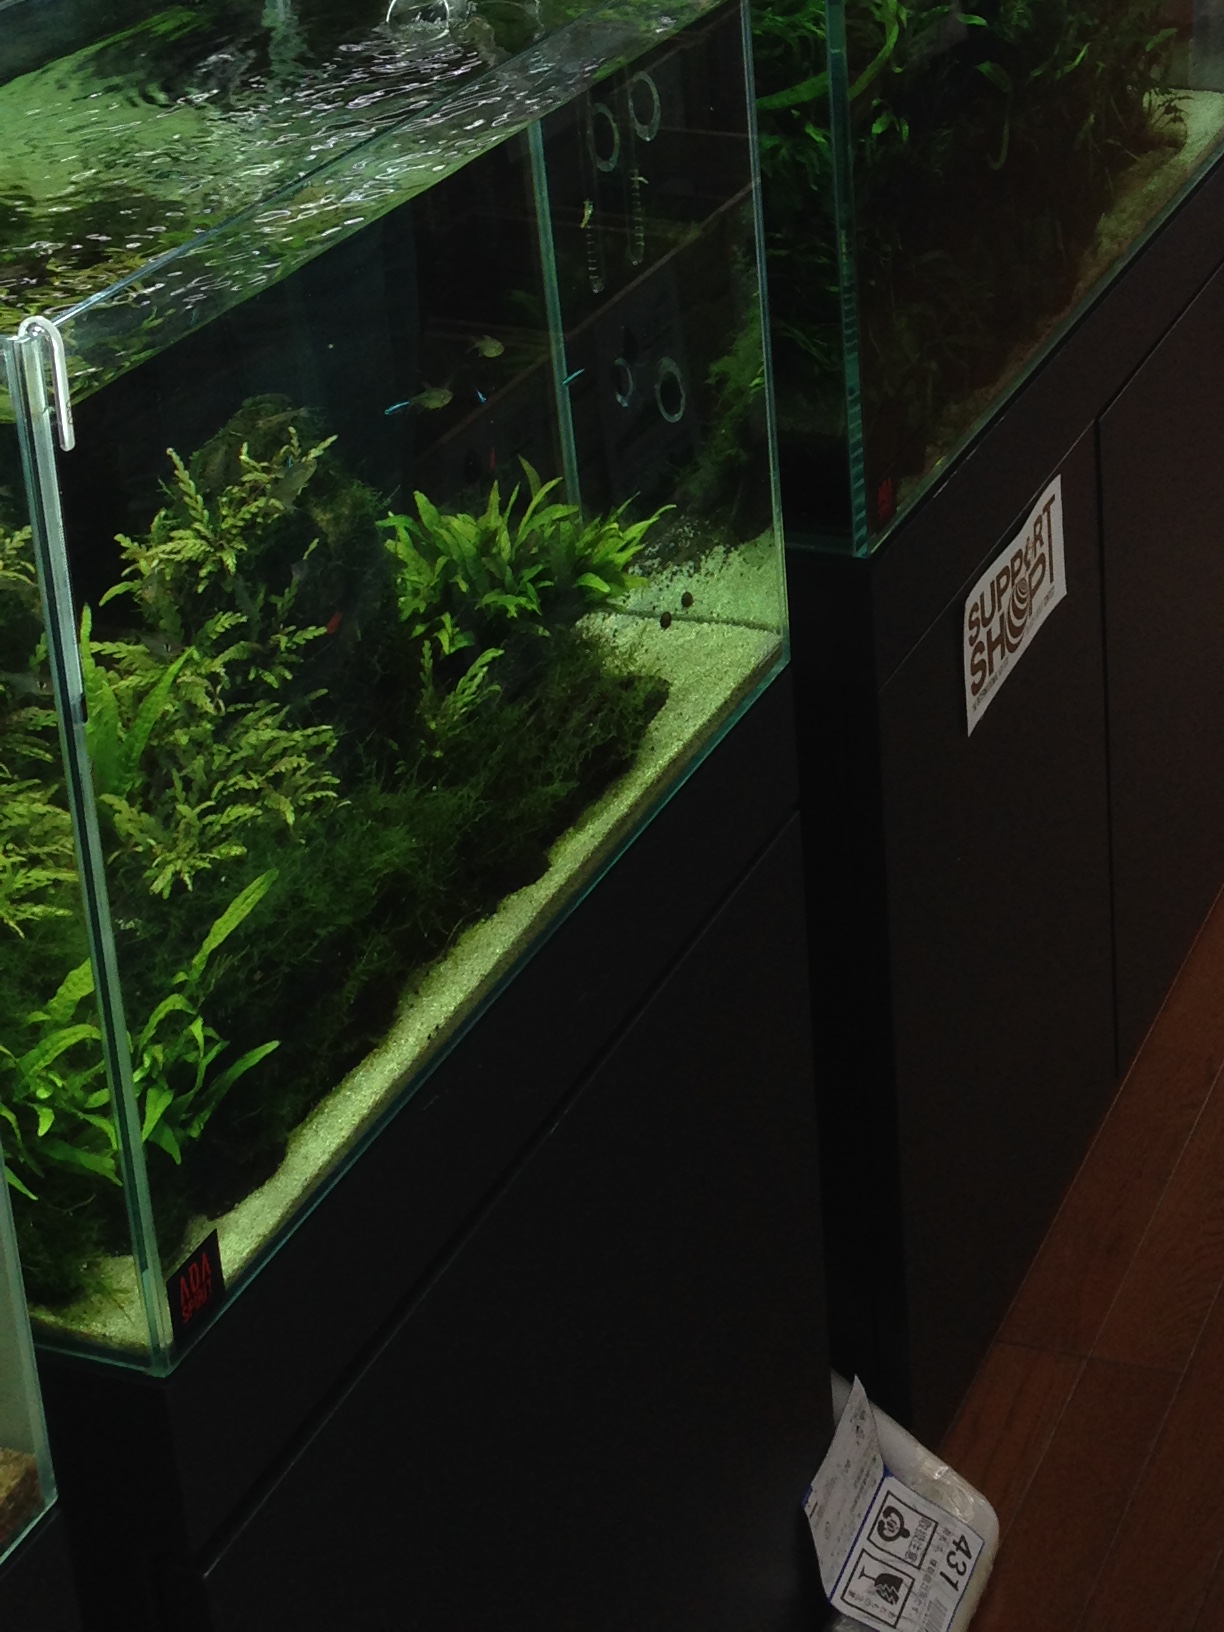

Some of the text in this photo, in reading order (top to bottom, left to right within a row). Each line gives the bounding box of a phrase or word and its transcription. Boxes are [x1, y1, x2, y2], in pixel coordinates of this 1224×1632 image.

[968, 494, 1056, 648] SUPPORT
[970, 551, 1047, 697] SHOP
[939, 1534, 973, 1593] 431
